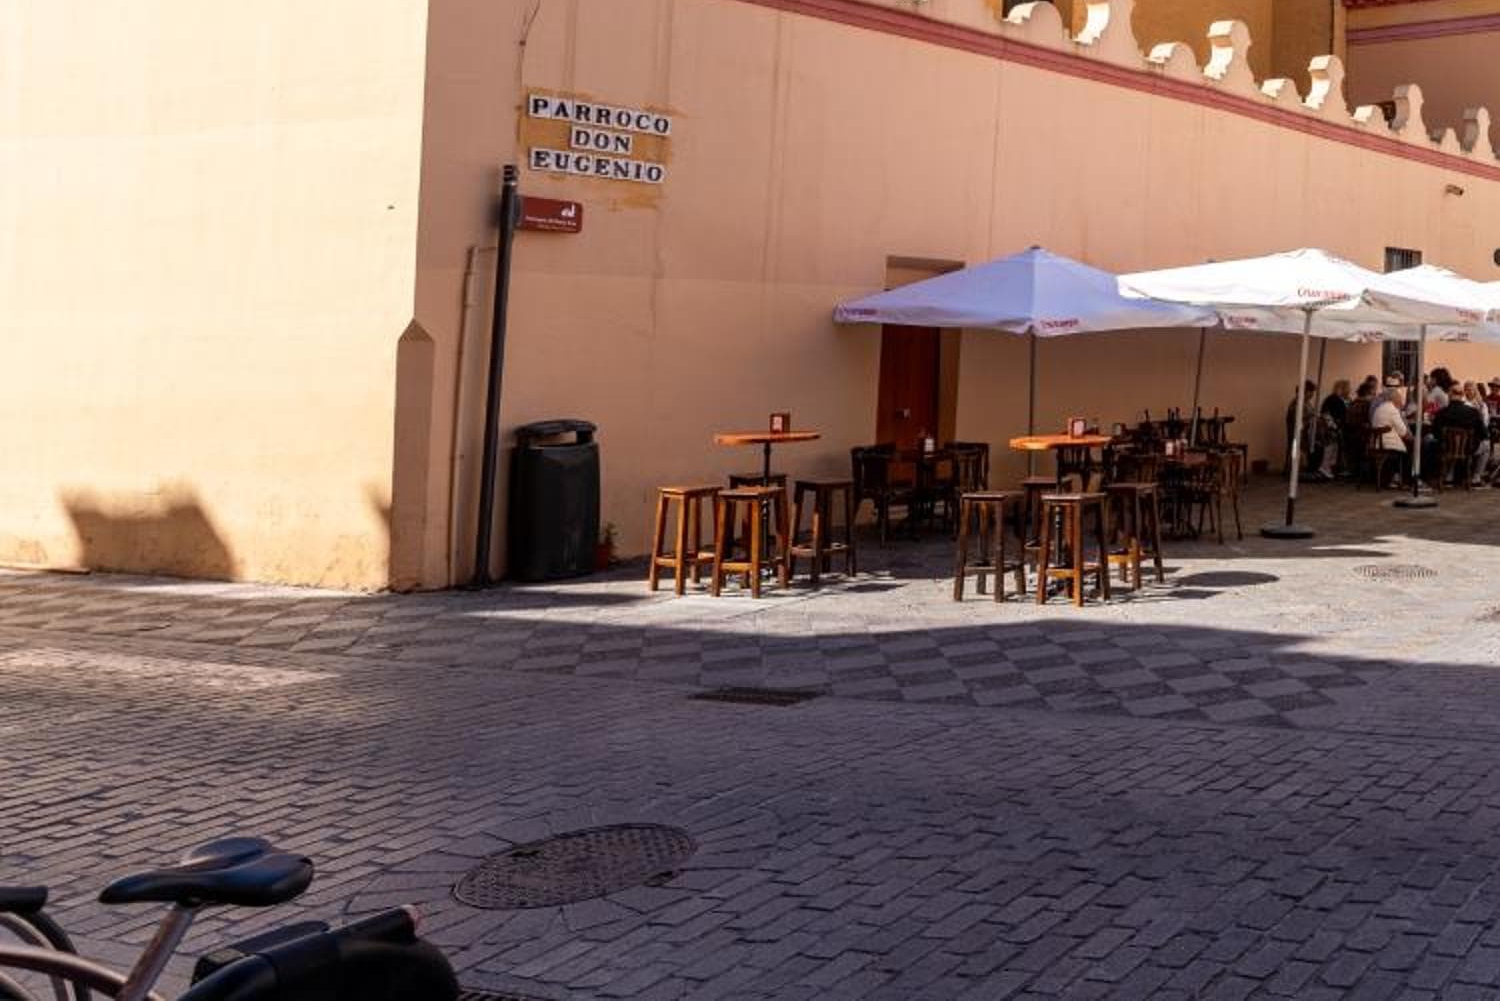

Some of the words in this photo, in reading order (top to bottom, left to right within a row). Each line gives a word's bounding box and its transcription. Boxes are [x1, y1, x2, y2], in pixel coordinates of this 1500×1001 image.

[532, 98, 669, 133] PARROCO
[574, 130, 630, 151] DON
[533, 150, 662, 182] EUGENIO
